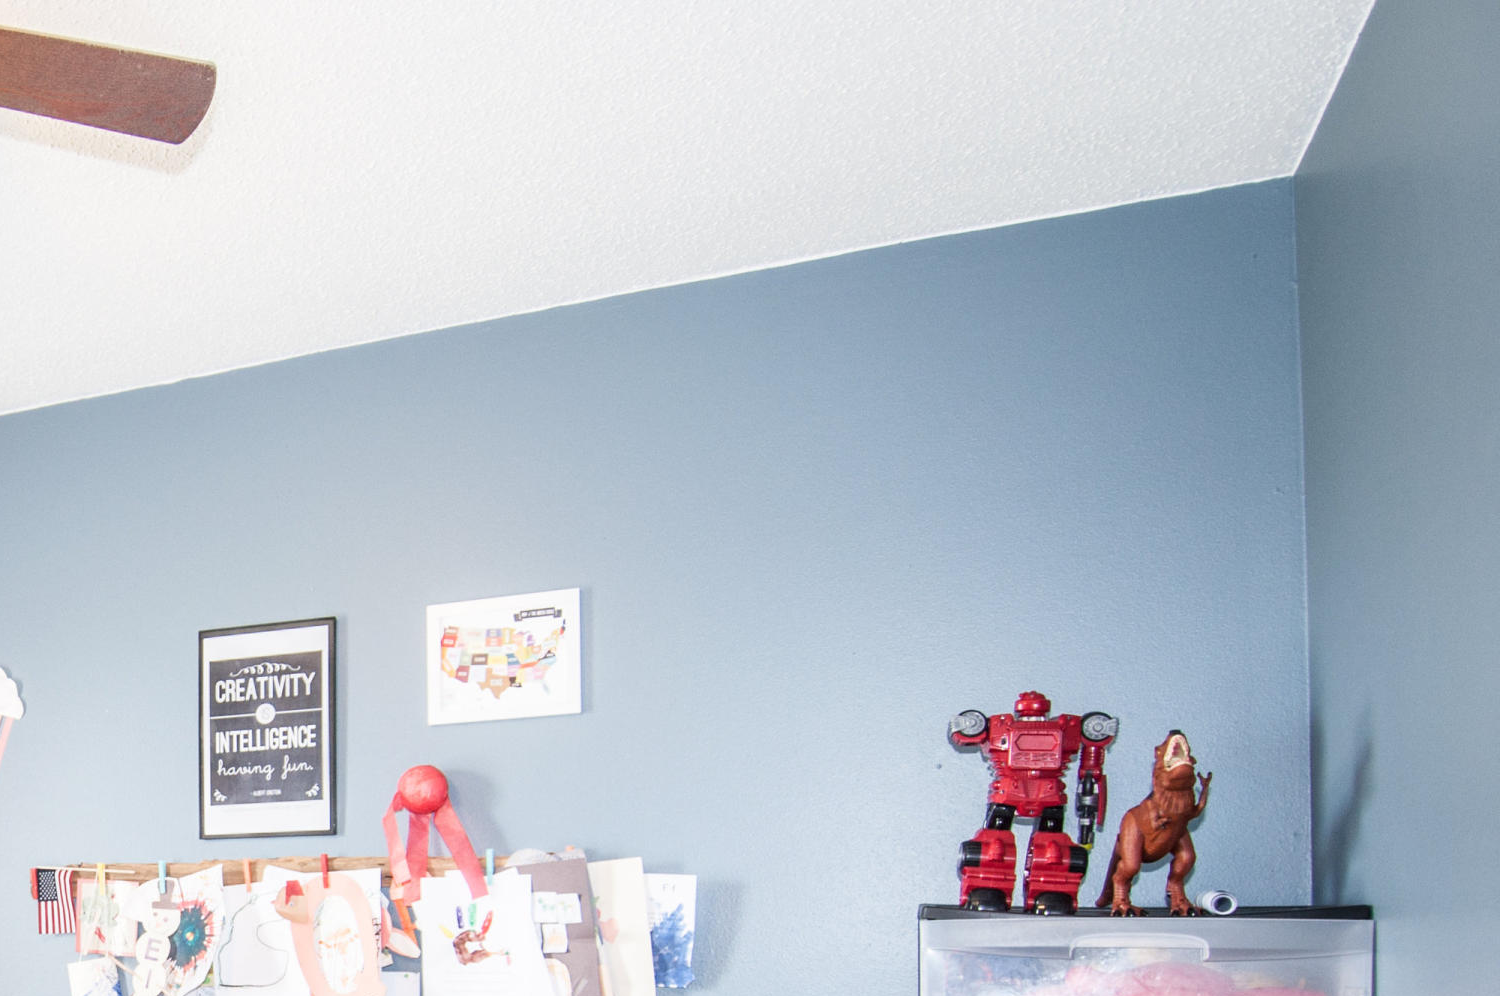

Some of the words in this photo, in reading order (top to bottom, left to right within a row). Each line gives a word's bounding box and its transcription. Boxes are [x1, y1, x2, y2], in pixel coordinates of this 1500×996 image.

[215, 671, 316, 703] CREATIVITY
[215, 724, 317, 754] INTELLIGENCE
[217, 759, 275, 781] having
[281, 754, 314, 780] fun.
